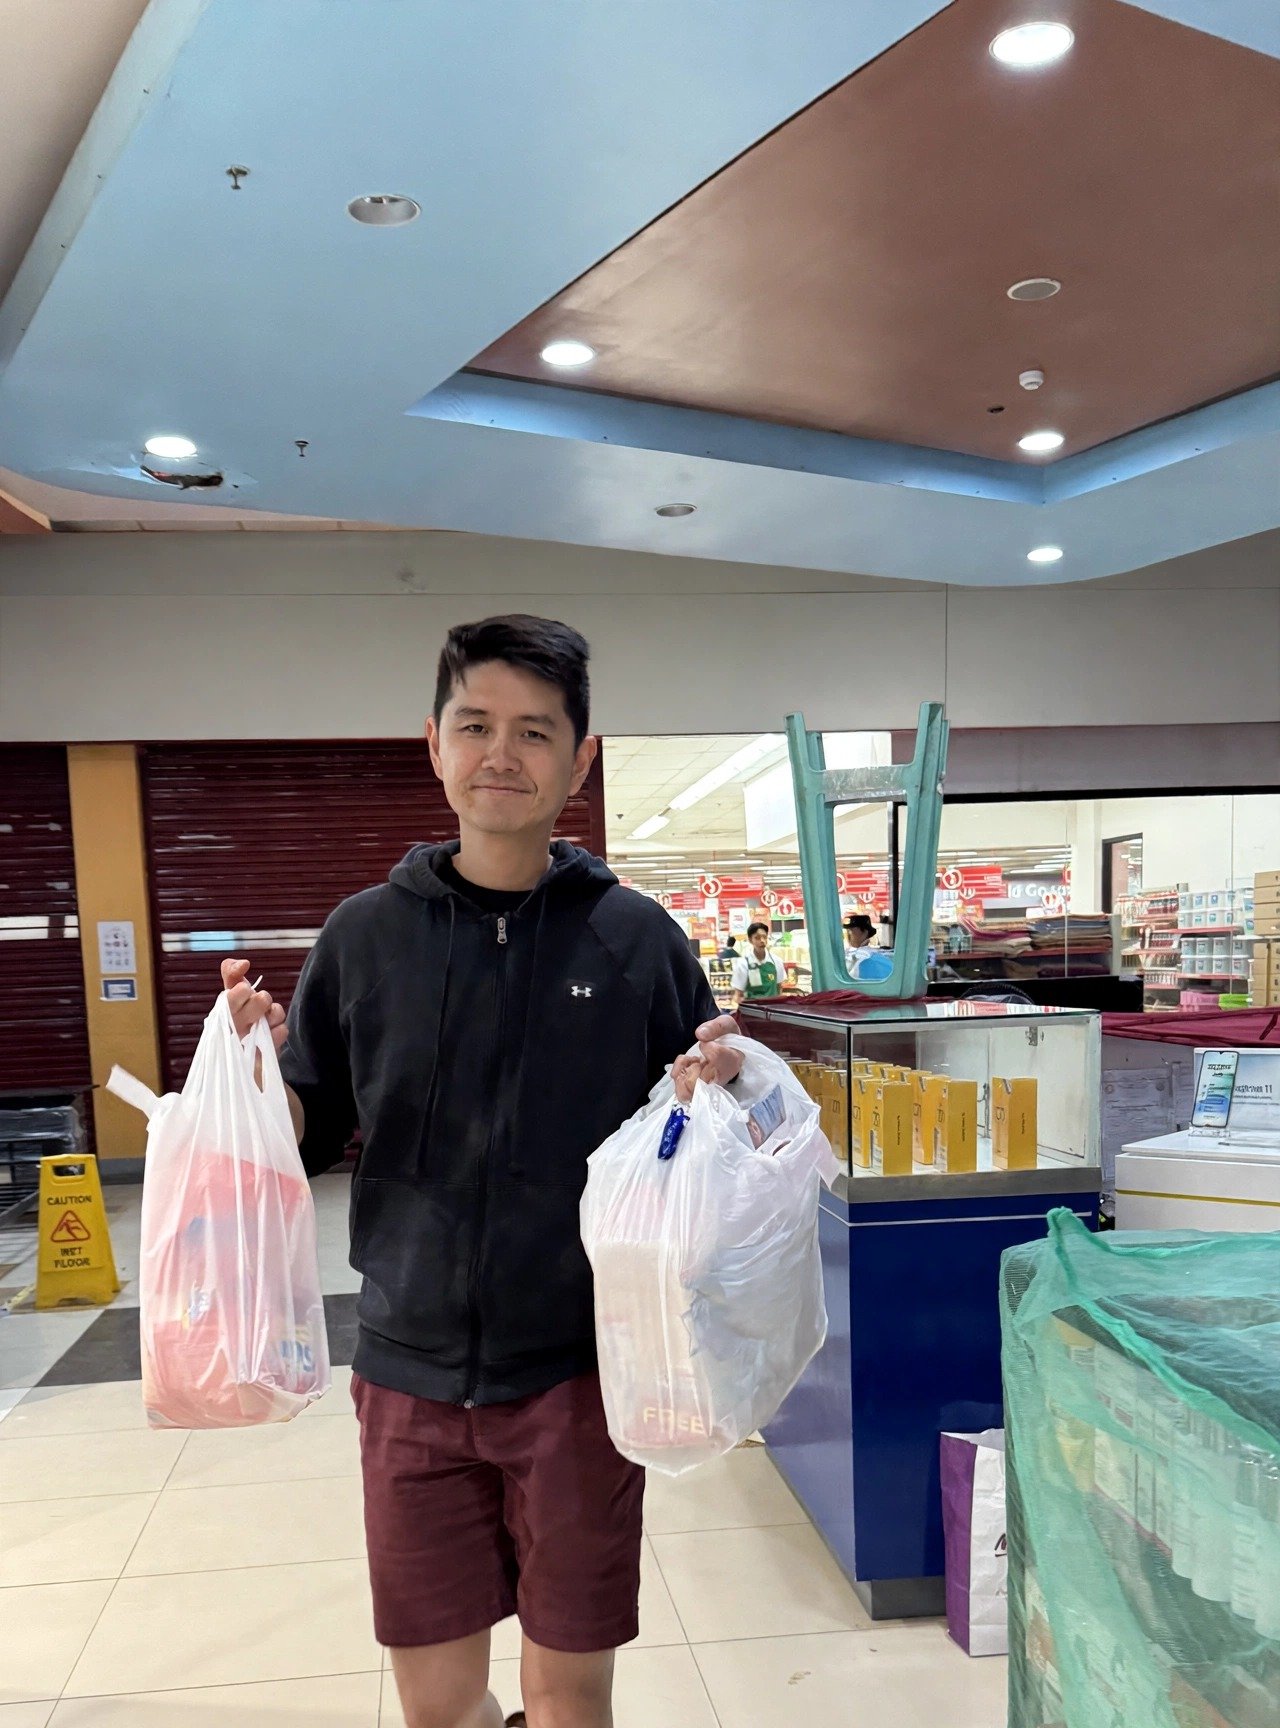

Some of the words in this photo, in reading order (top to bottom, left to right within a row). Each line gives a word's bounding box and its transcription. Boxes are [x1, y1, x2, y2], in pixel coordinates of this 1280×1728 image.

[47, 1195, 92, 1206] CAUTION
[61, 1246, 82, 1257] WET
[54, 1257, 91, 1269] FLOOR
[643, 1406, 704, 1434] FREE
